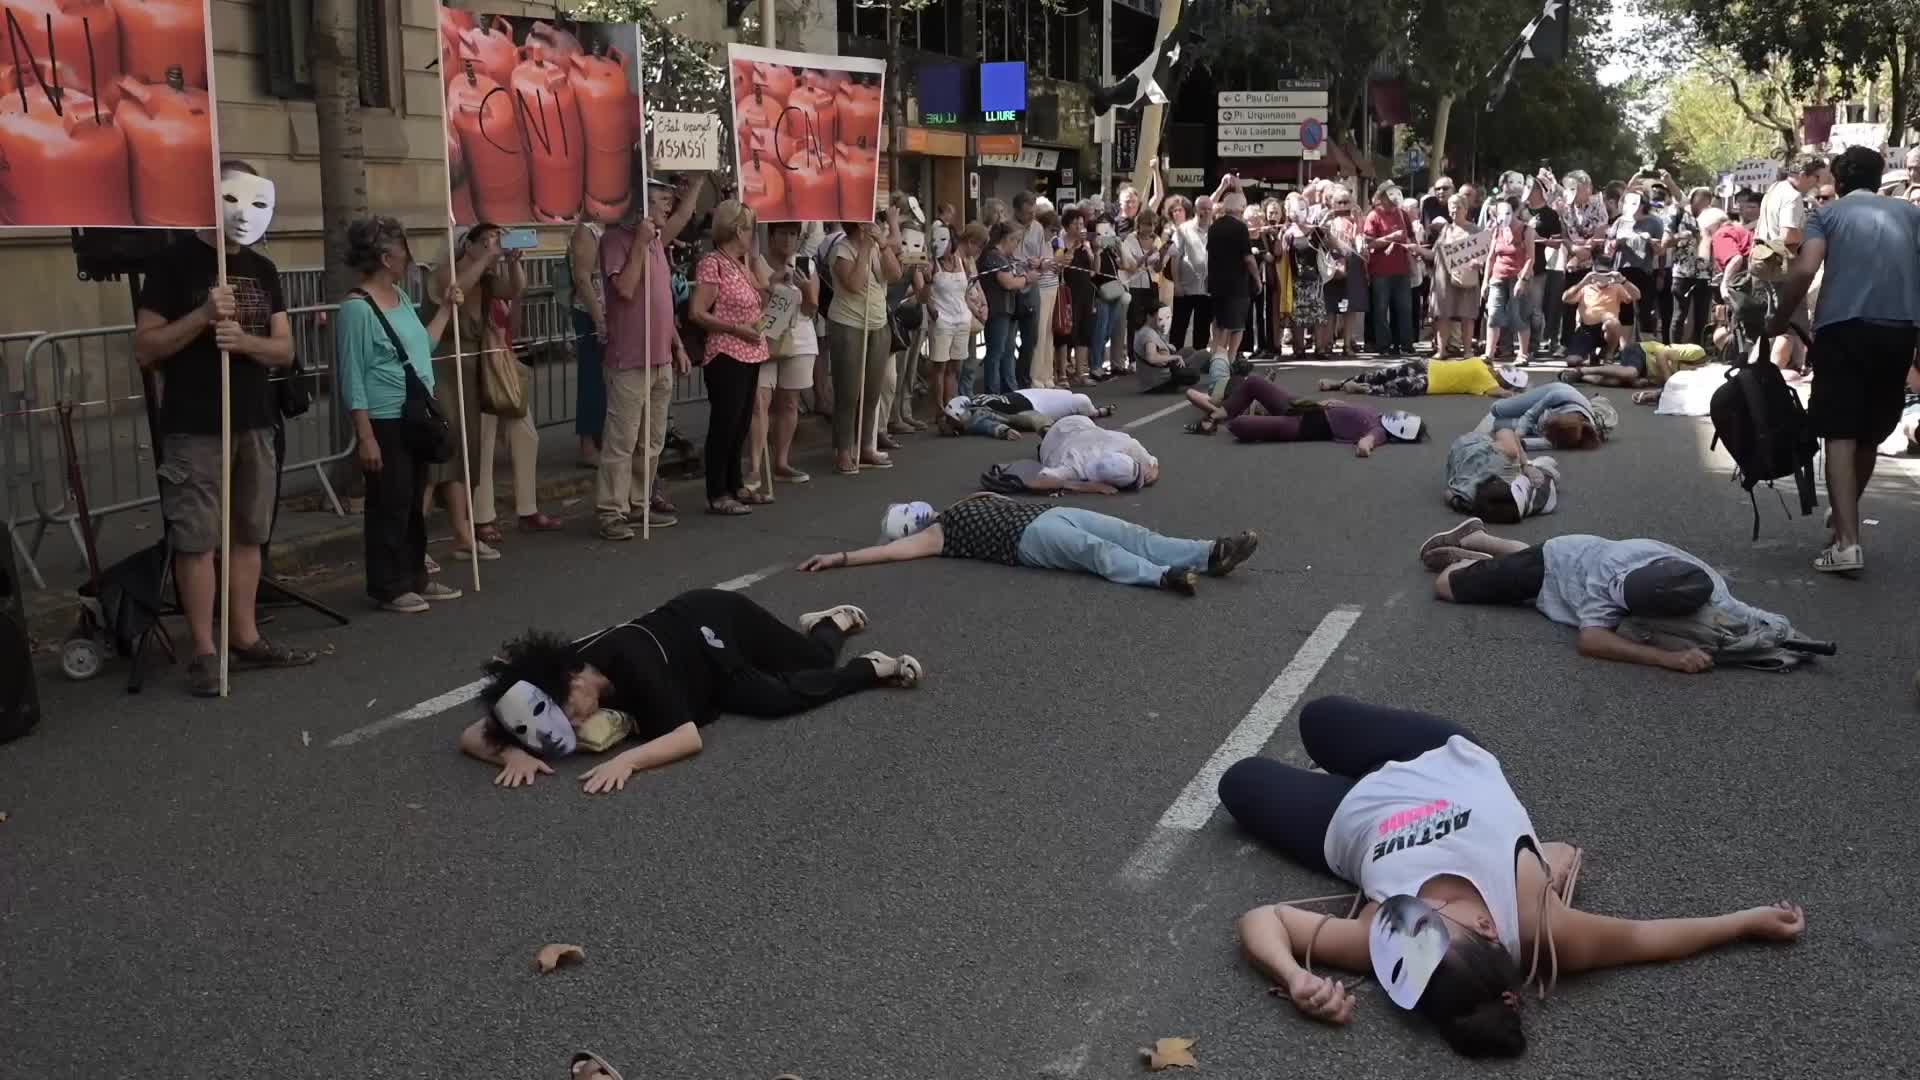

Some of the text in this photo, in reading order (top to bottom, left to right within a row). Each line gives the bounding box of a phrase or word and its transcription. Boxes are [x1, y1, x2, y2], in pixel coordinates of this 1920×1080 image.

[985, 110, 1016, 122] LLIURE
[479, 87, 568, 159] CNI
[1234, 127, 1286, 137] Via Laietana
[1233, 143, 1251, 153] Port
[1372, 808, 1473, 863] ACTIVE
